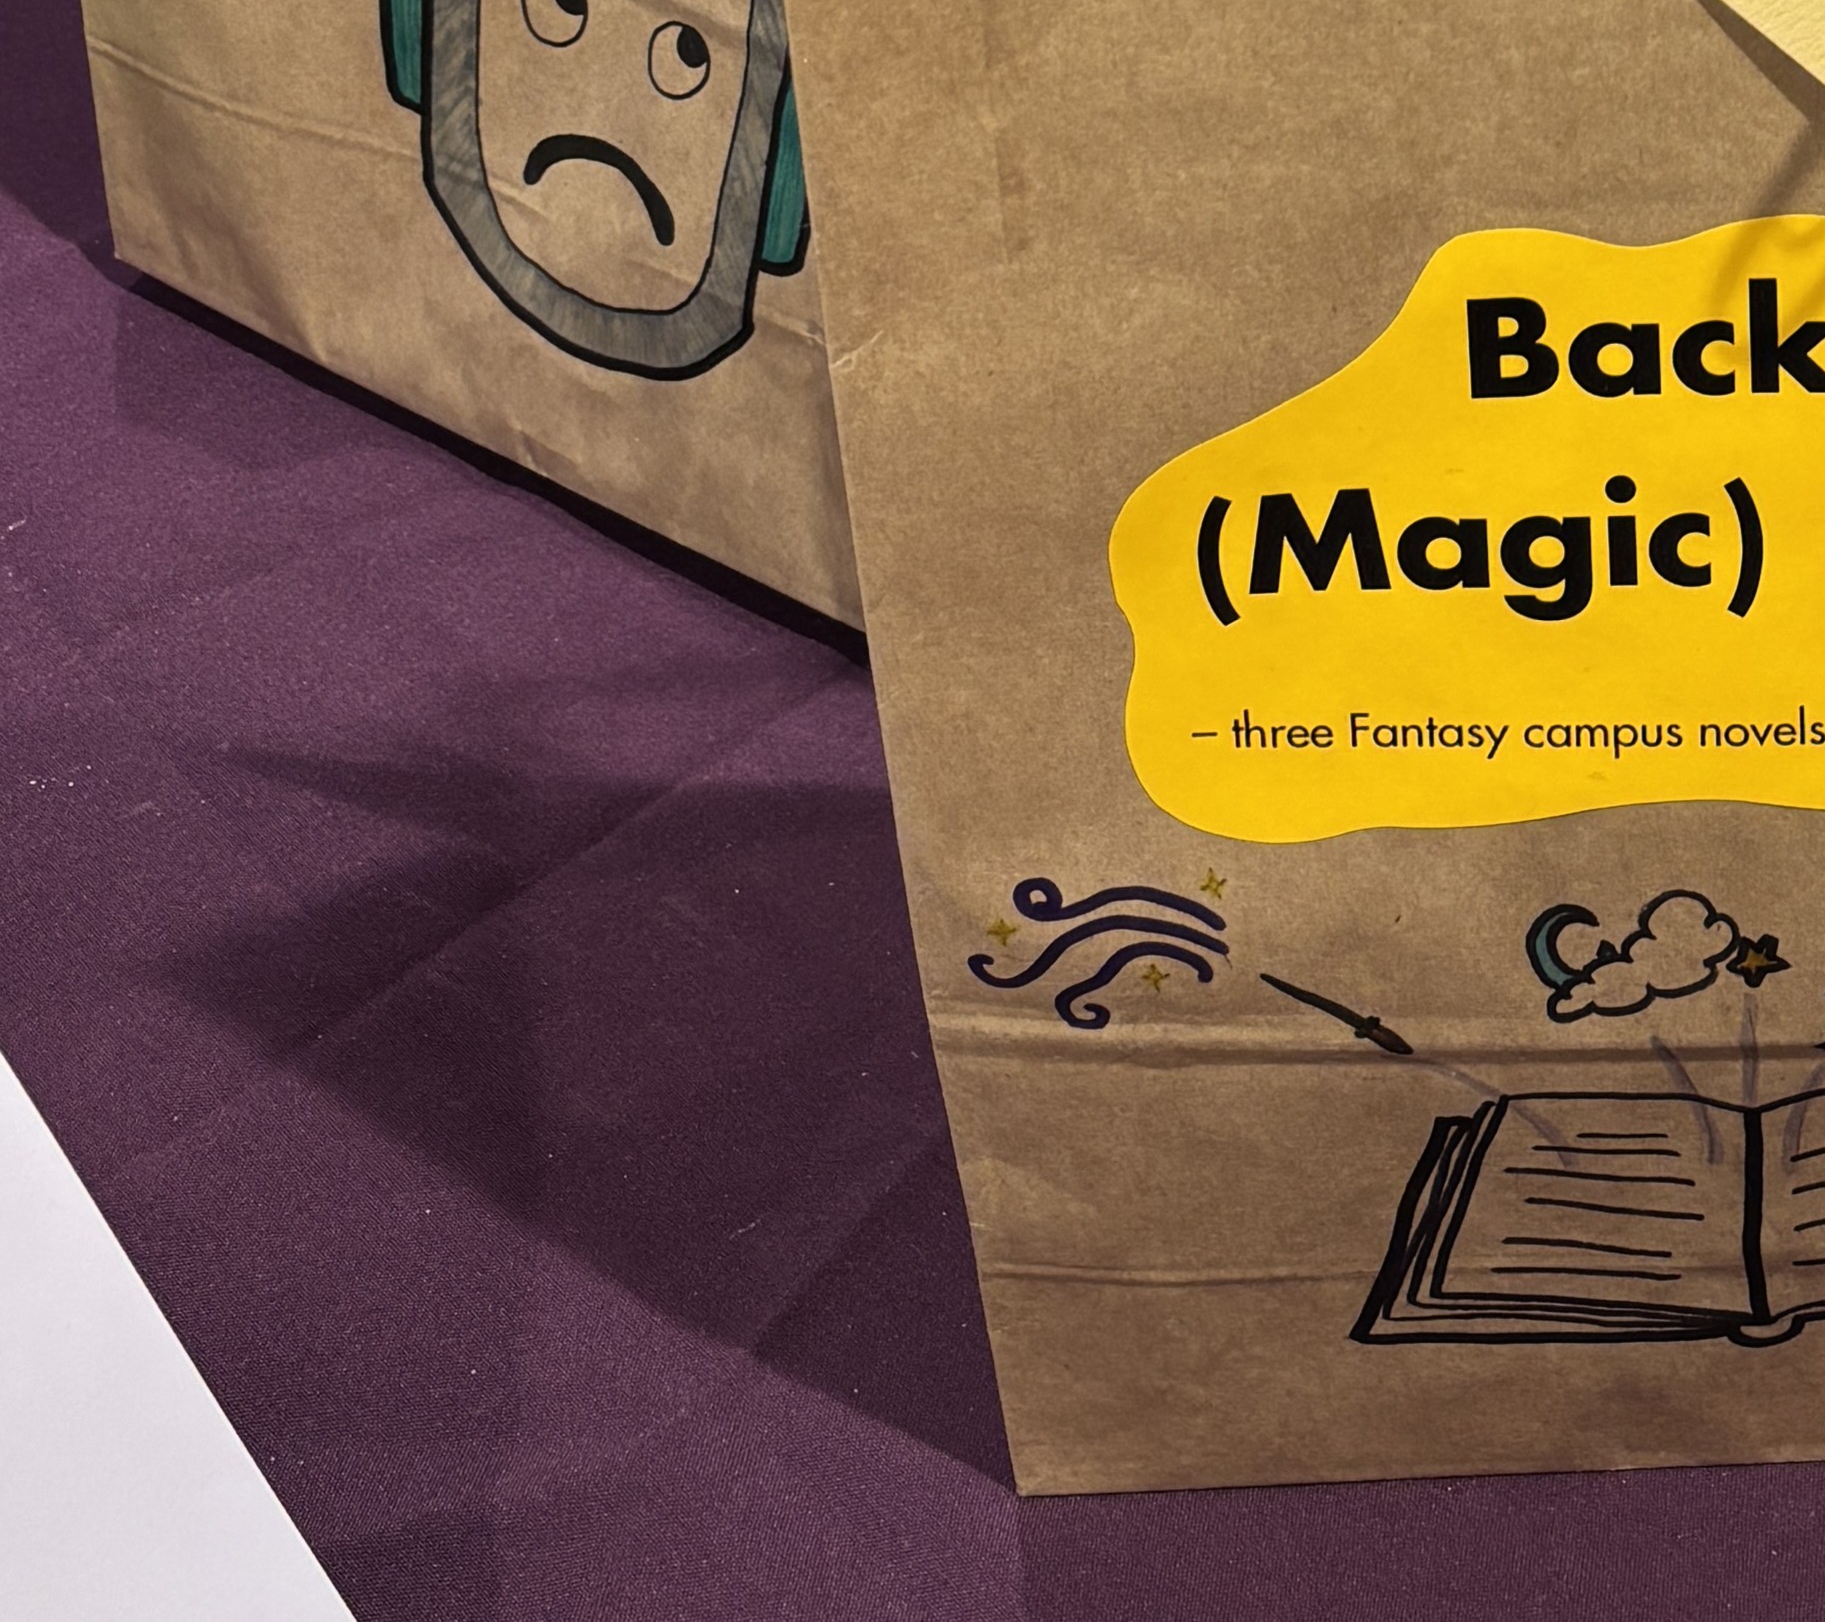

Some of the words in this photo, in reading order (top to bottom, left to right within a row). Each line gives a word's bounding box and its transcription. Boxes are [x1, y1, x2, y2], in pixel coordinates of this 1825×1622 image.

[1196, 474, 1765, 628] (Magic)
[1231, 710, 1335, 750] three
[1348, 711, 1510, 760] Fantasy
[1523, 719, 1684, 761] campus
